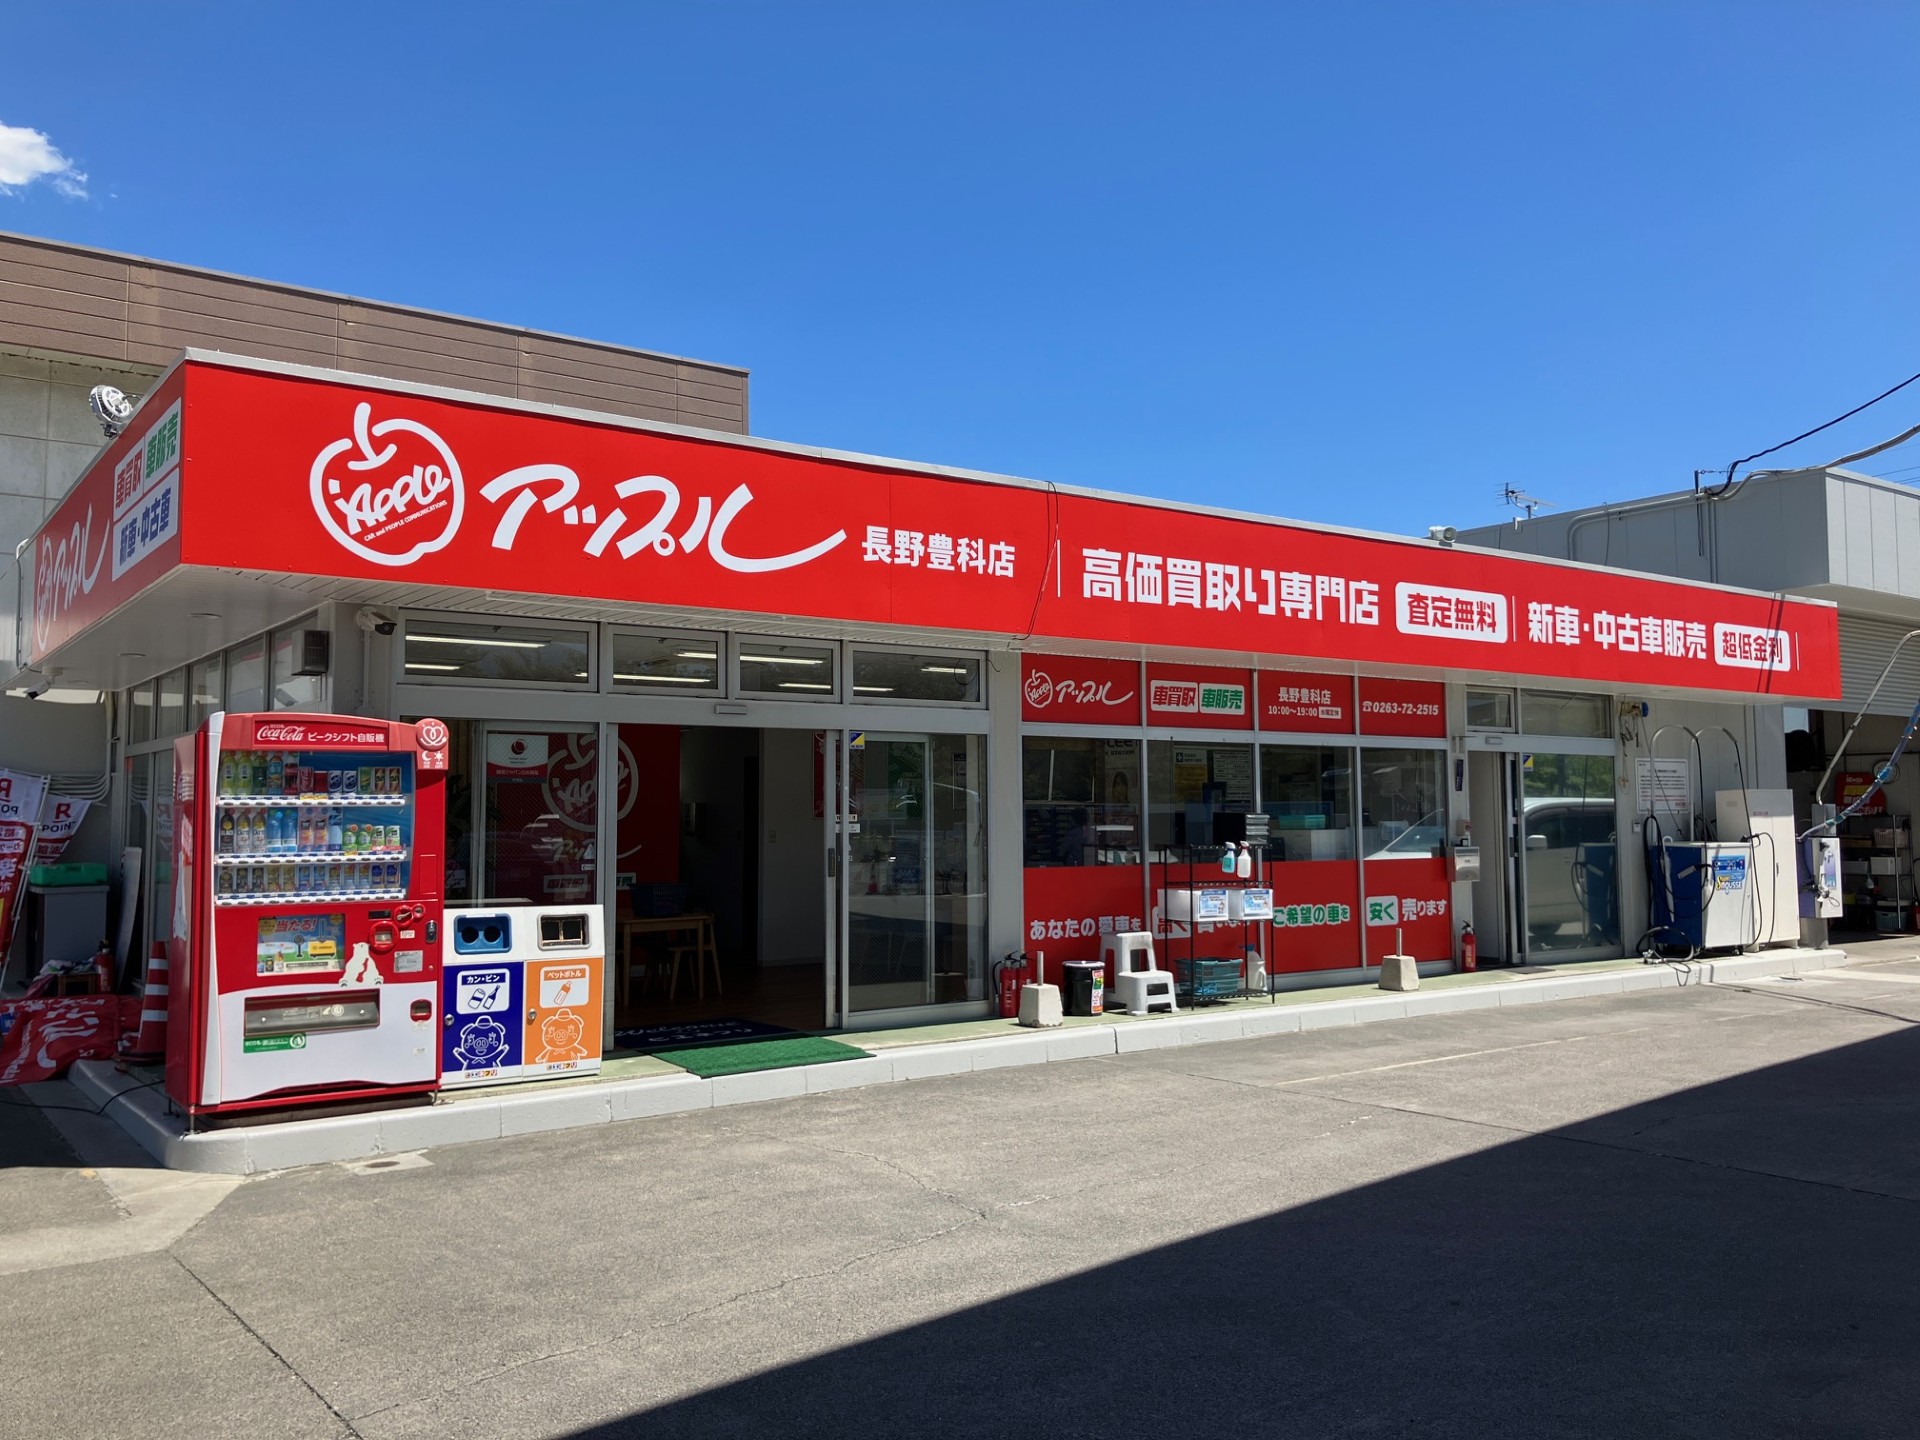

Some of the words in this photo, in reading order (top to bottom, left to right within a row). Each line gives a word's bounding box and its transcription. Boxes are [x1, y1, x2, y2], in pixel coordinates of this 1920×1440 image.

[145, 412, 178, 480] 車販売
[115, 447, 142, 508] 車買取
[364, 532, 376, 542] CAR
[386, 519, 405, 533] PEOPLE
[404, 500, 448, 523] COMMUNICATIONS
[479, 463, 847, 574] アップル
[862, 525, 1016, 578] 長野豊科店
[1082, 548, 1379, 626] 高価買取り専門店
[1407, 593, 1497, 633] 査定無料
[1528, 601, 1707, 660] 新車・中古車販売
[1722, 630, 1784, 664] 超低金利
[1055, 680, 1134, 705] アップル
[1153, 685, 1196, 707] 車買取
[1201, 688, 1244, 710] 車販売
[1278, 687, 1331, 705] 長野豊科店
[257, 726, 306, 741] Coca-Cola
[1369, 902, 1395, 921] 安く
[1402, 898, 1448, 922] 売ります
[1030, 915, 1142, 941] あなたの愛車を
[547, 970, 582, 979] ペットボトル
